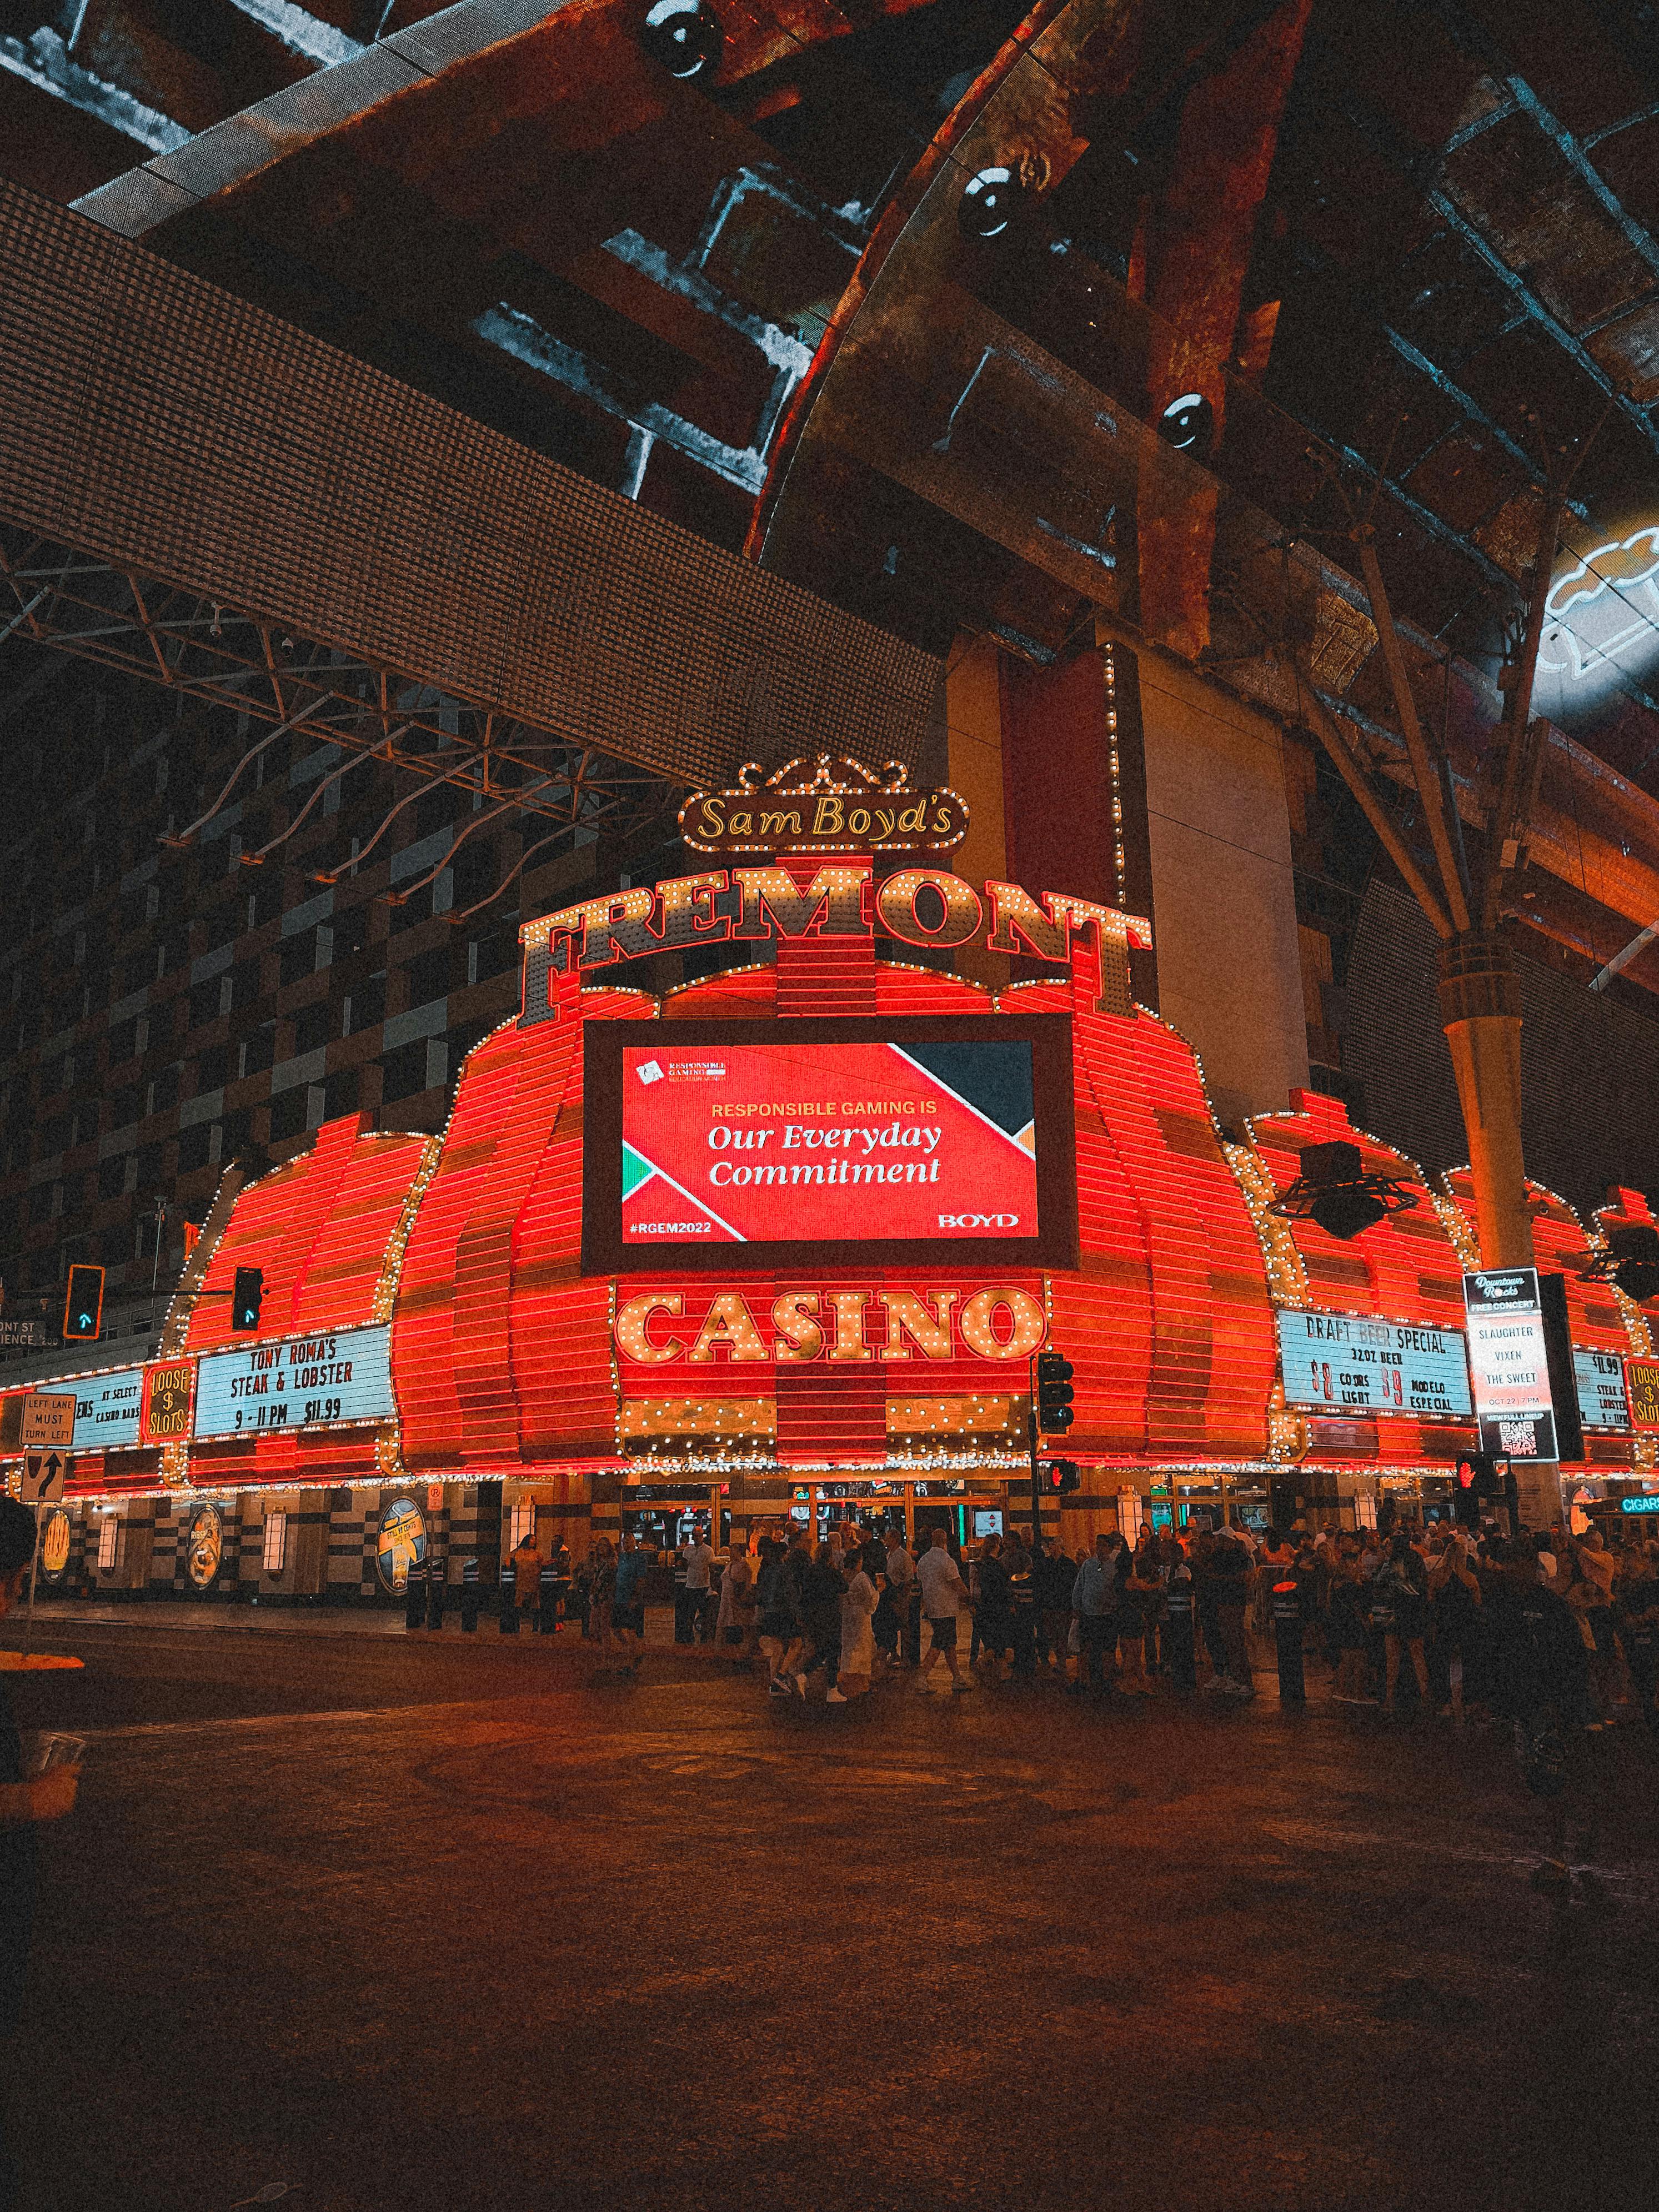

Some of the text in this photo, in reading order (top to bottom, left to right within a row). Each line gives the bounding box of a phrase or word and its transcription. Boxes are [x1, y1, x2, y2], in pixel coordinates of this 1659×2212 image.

[696, 794, 952, 842] Sam Boyd's
[516, 865, 1154, 1032] FREMONT
[711, 1102, 938, 1117] RESPONSIBLE GAMING IS
[707, 1123, 942, 1155] Our Everyday
[709, 1158, 941, 1186] Commitment
[629, 1222, 712, 1234] #RGEM2022
[938, 1214, 1019, 1228] BOYD
[1475, 1276, 1525, 1288] Downtown
[1483, 1286, 1519, 1298] Rocks
[1471, 1300, 1535, 1312] FREE CONCERT
[22, 1322, 34, 1332] ST
[614, 1286, 1047, 1365] CASINO
[1479, 1326, 1533, 1340] SLAUGHTER
[1306, 1316, 1446, 1354] DRAFT BEER SPECIAL
[250, 1338, 337, 1372] TONY ROMA'S
[1380, 1351, 1404, 1365] BEER
[1495, 1351, 1522, 1361] VIXEN
[152, 1368, 188, 1397] LOOSE
[230, 1361, 353, 1398] STEAK & LOBSTER
[1339, 1372, 1370, 1387] COORS
[1486, 1372, 1537, 1385] THE SWEET
[102, 1386, 138, 1401] AT SELECT
[1411, 1380, 1445, 1395] MODELO
[1597, 1385, 1617, 1396] STEAK
[28, 1400, 72, 1409] LEFT LANE
[1341, 1390, 1370, 1405] LIGHT
[1410, 1396, 1453, 1411] ESPECIAL
[303, 1398, 341, 1424] $11.99
[1521, 1412, 1545, 1421] LINEUP
[35, 1414, 63, 1424] MUST
[149, 1408, 184, 1434] SLOTS
[234, 1410, 243, 1429] 9
[26, 1429, 70, 1439] TURN LEFT
